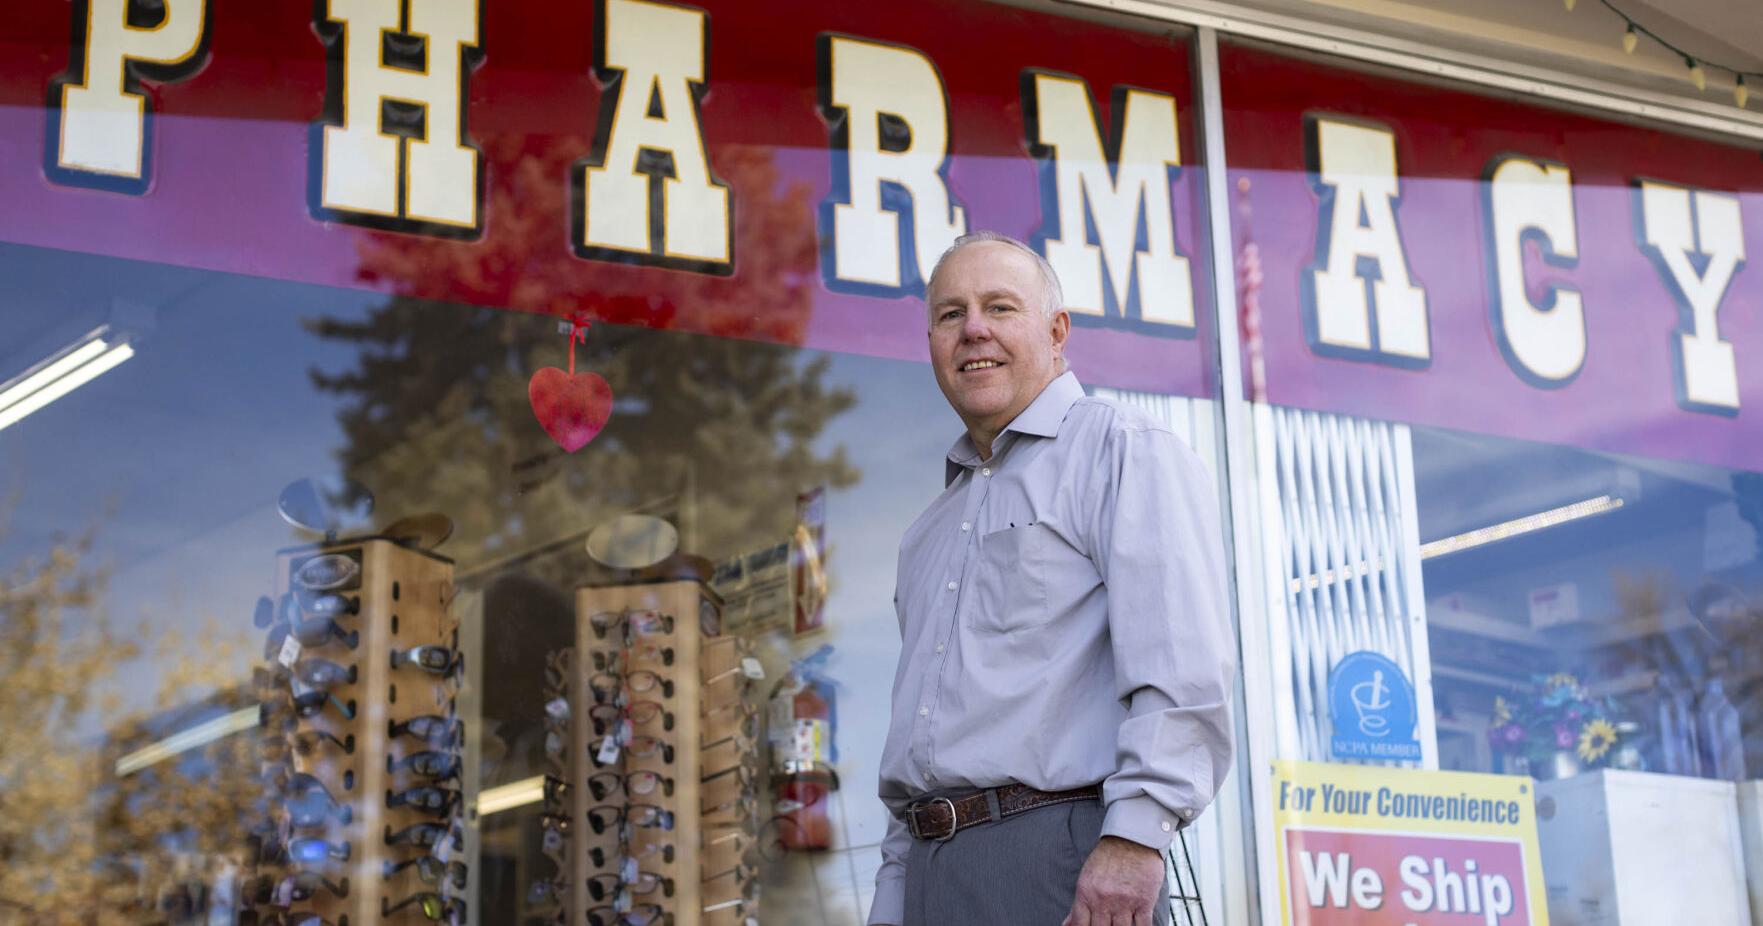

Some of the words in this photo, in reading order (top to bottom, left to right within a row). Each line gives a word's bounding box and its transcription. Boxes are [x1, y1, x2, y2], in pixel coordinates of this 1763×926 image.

[45, 0, 1748, 417] PHARMACY
[1333, 741, 1368, 755] NCPA
[1371, 742, 1420, 758] MEMBER
[1279, 781, 1316, 812] For
[1321, 783, 1371, 816] Your
[1376, 787, 1520, 824] Convenience
[1300, 850, 1384, 910] We
[1400, 855, 1514, 926] Ship
